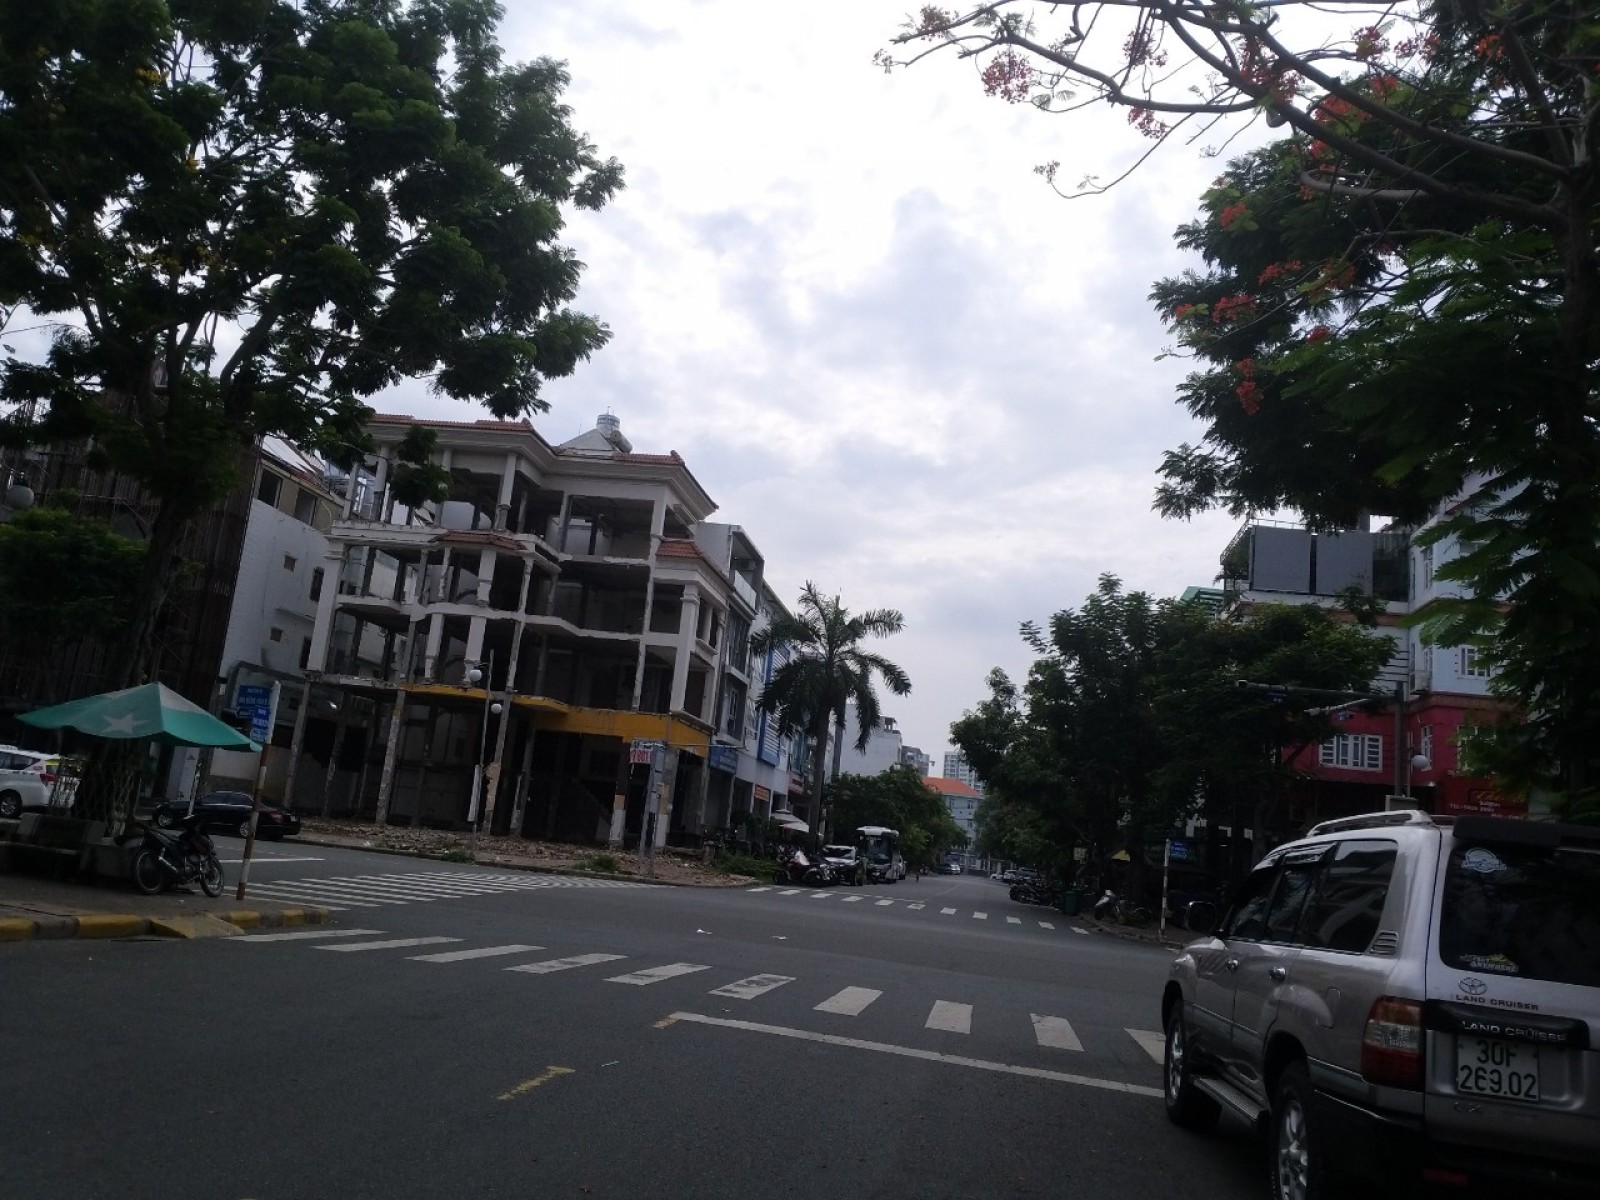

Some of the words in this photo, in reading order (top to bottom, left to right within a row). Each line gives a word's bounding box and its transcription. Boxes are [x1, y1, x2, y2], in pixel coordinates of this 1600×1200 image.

[1455, 994, 1485, 1004] LAND
[1490, 999, 1539, 1011] CRUISER
[1462, 1020, 1500, 1034] LAND
[1505, 1026, 1568, 1042] CRUISER
[1477, 1039, 1518, 1068] 30F
[1460, 1064, 1537, 1100] 269.02
